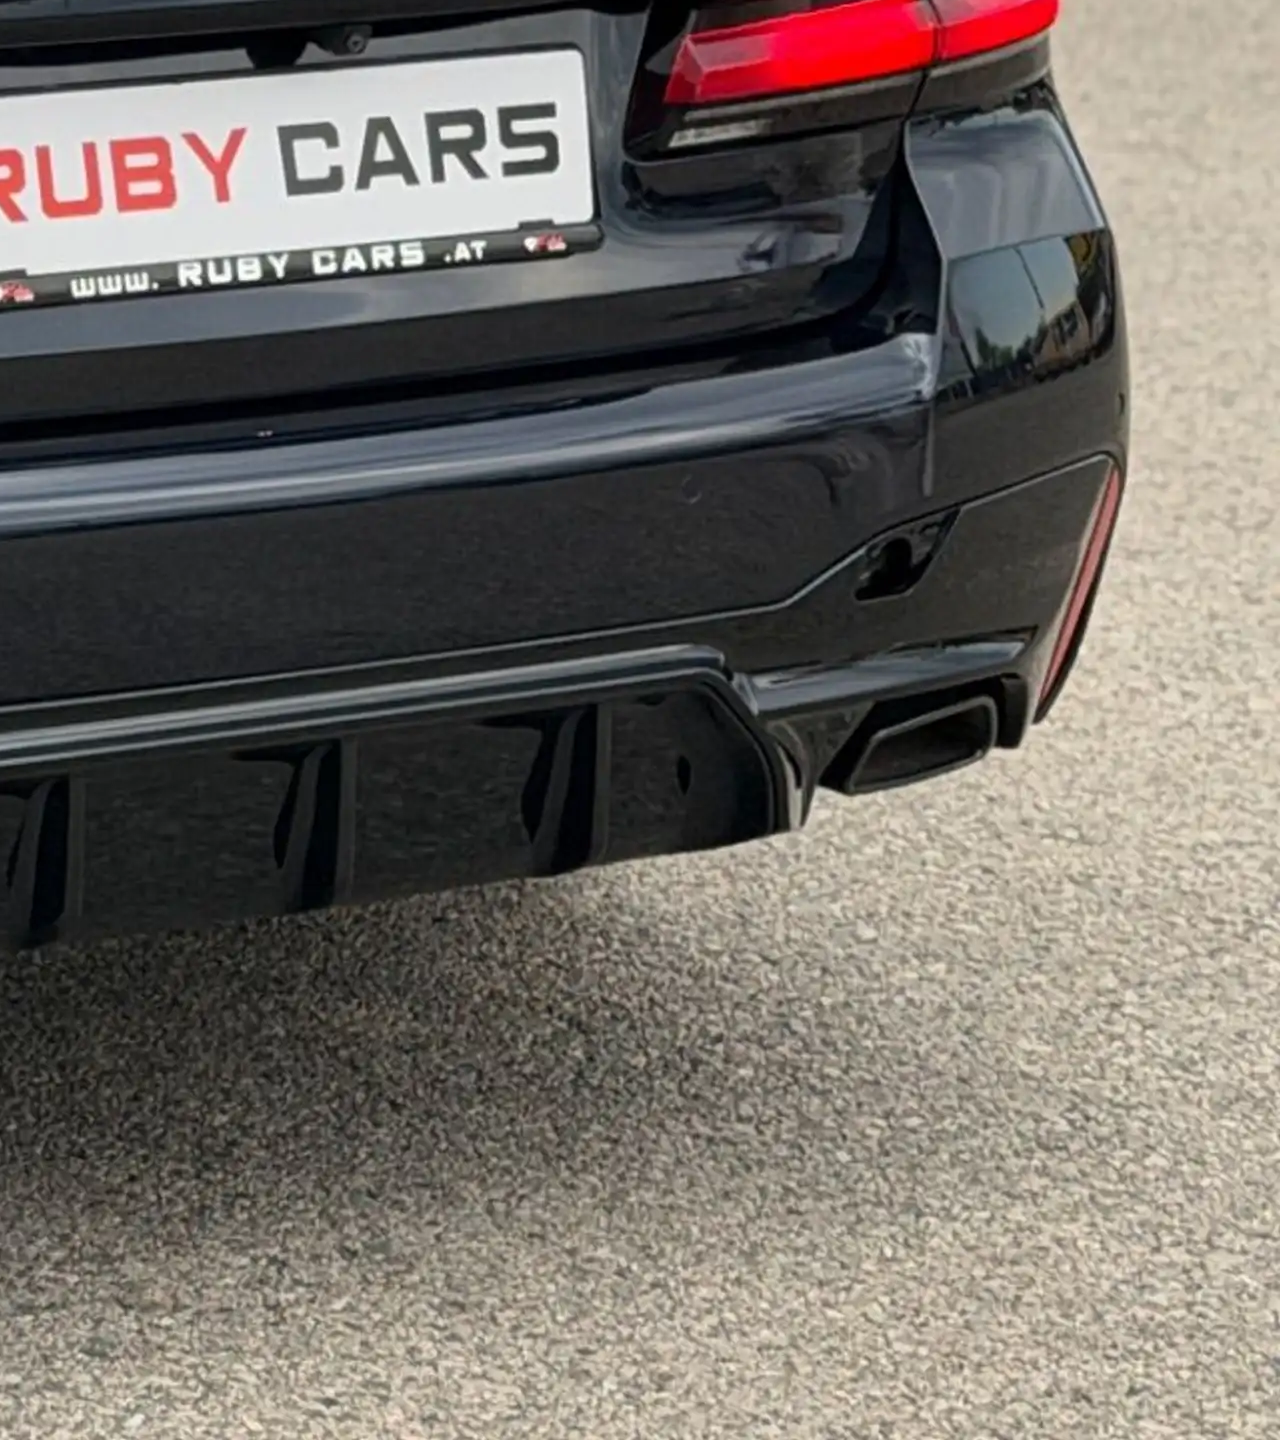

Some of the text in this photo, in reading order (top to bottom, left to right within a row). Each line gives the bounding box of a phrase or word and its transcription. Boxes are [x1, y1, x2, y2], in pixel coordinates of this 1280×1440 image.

[277, 103, 560, 197] CARS
[177, 253, 290, 287] RUBY
[312, 241, 425, 276] CARS
[443, 240, 488, 264] .AT
